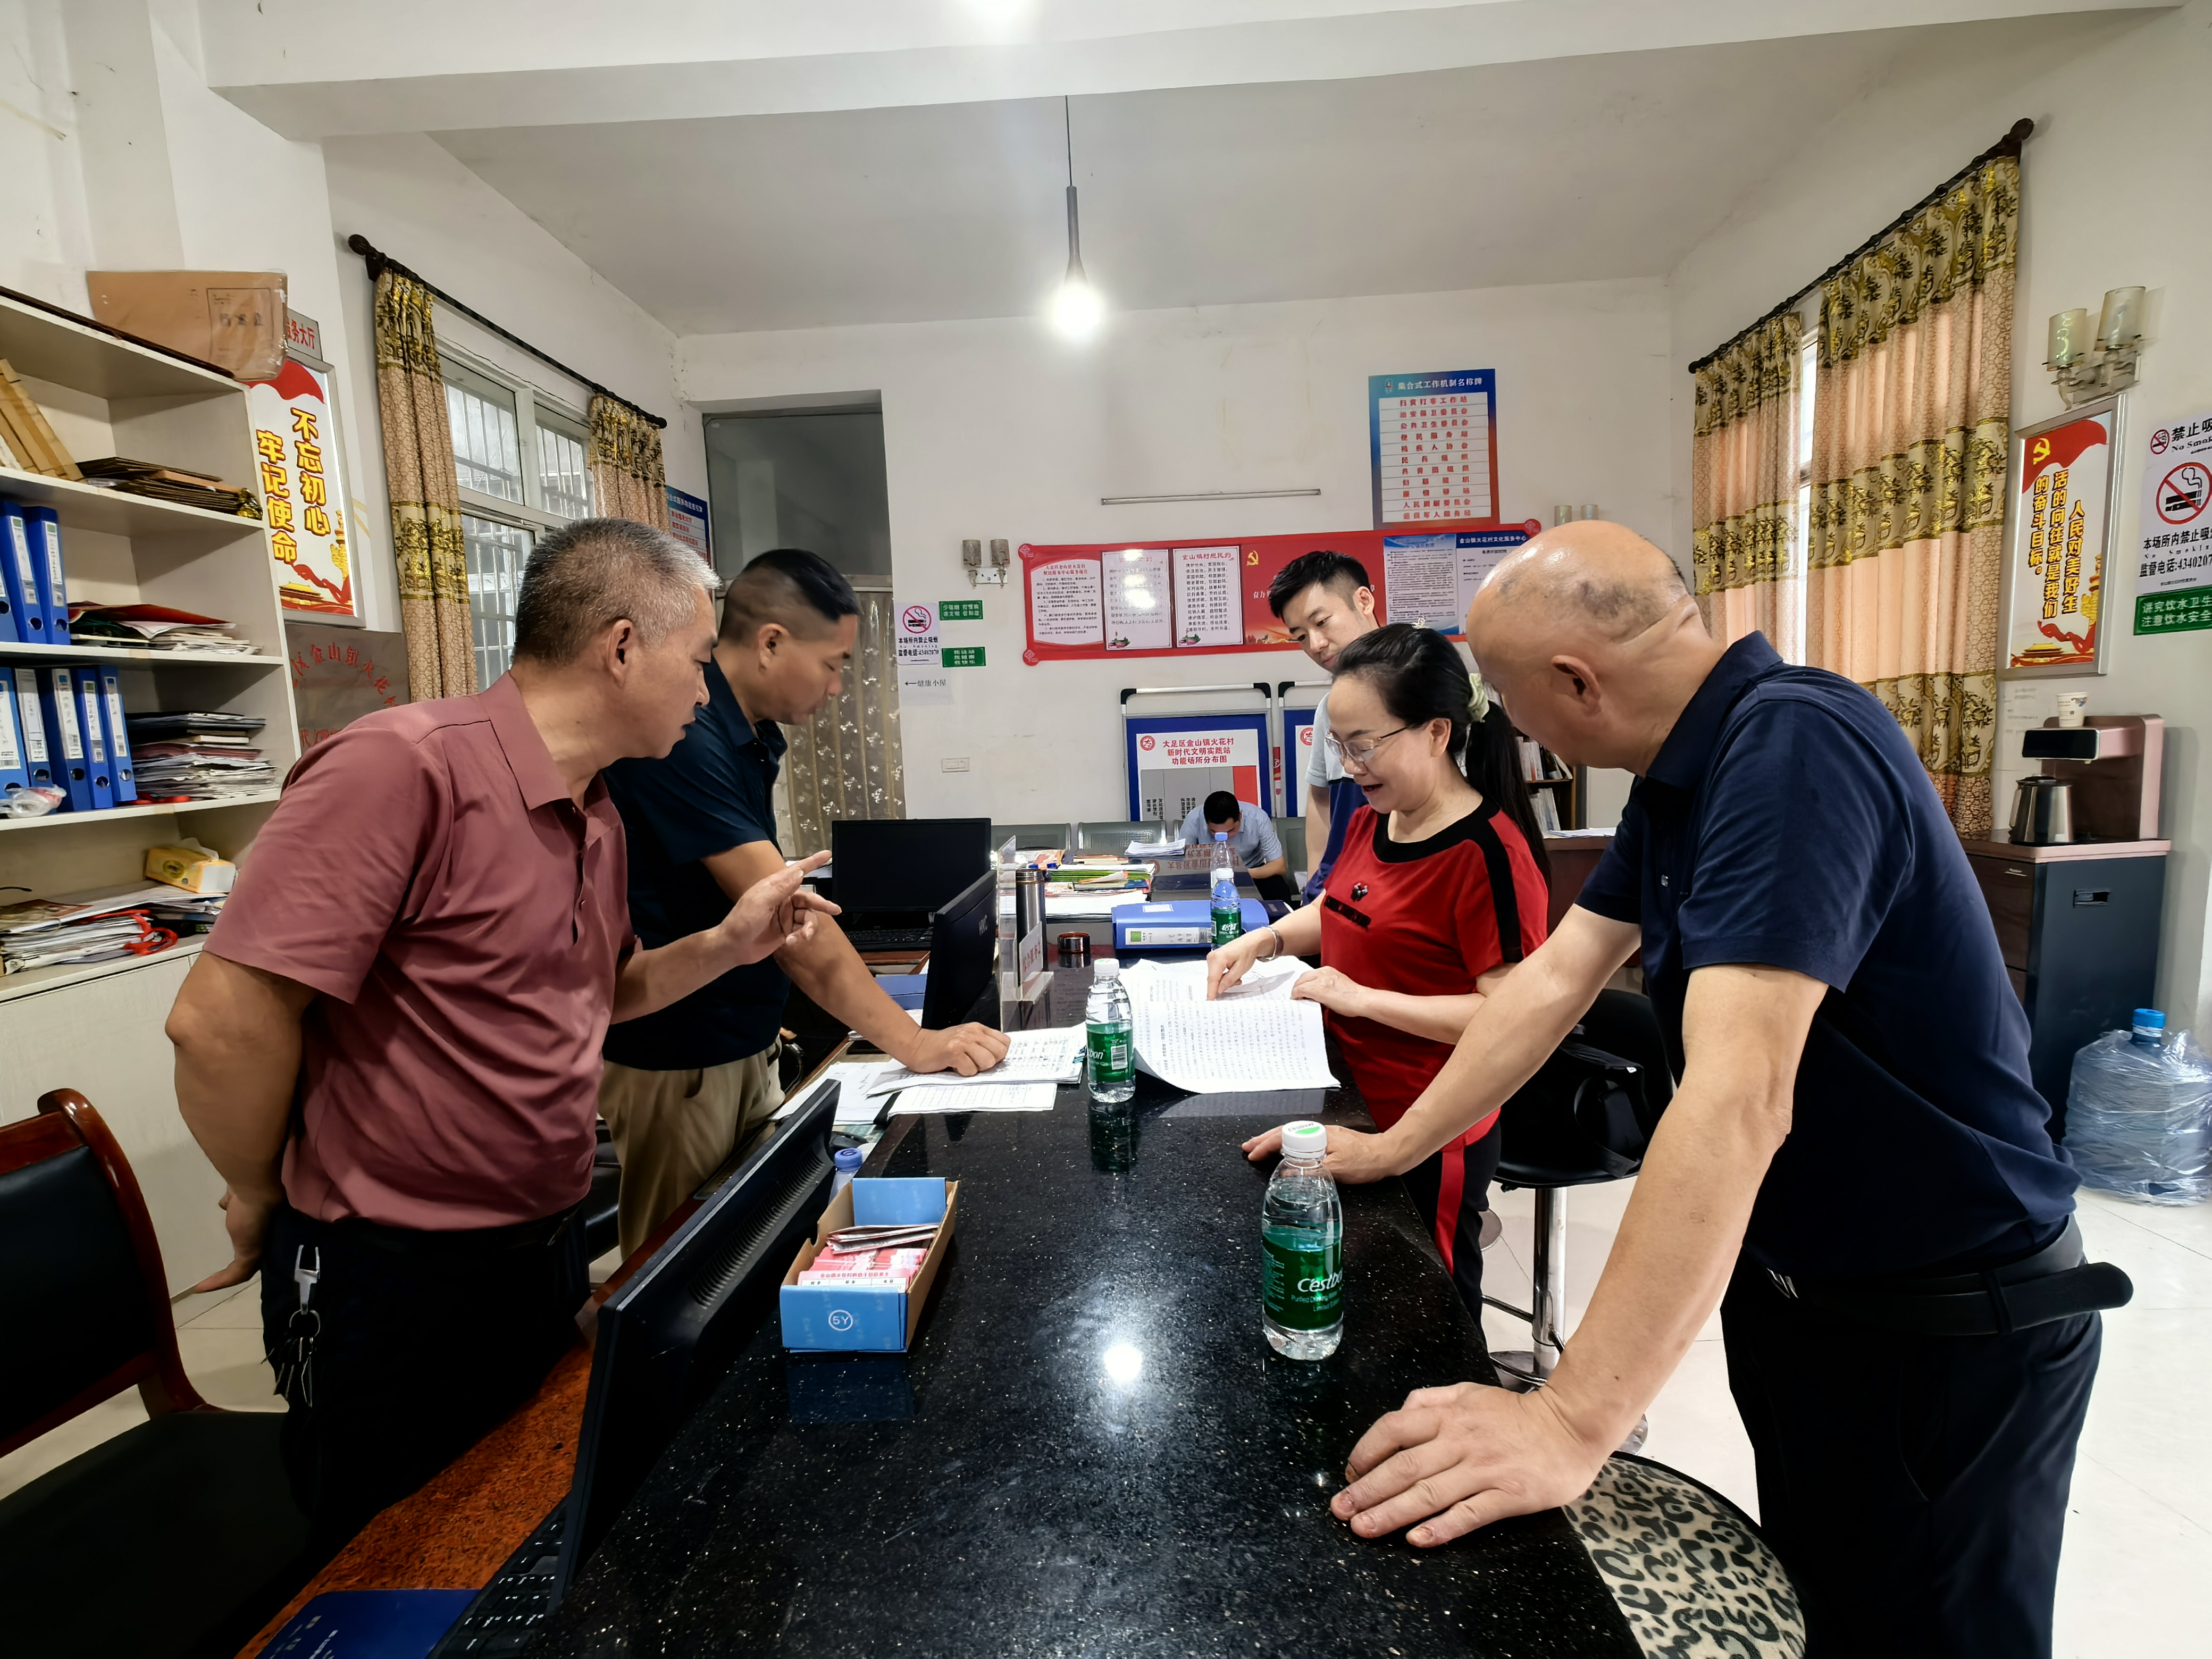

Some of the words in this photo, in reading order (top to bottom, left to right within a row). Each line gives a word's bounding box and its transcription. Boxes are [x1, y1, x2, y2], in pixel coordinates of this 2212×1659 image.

[2172, 418, 2212, 442] 禁止吸
[290, 407, 331, 537] 不忘初心
[256, 429, 297, 565] 牢记使命
[2042, 469, 2069, 619] 活的向往就是我们
[2143, 526, 2212, 550] 本场所内禁止吸
[2062, 499, 2085, 614] 人民对美好生
[1163, 738, 1234, 748] 大足区金山镇火花村
[1167, 747, 1230, 756] 新时代文明实践站
[1172, 756, 1227, 765] 功能场所分布图
